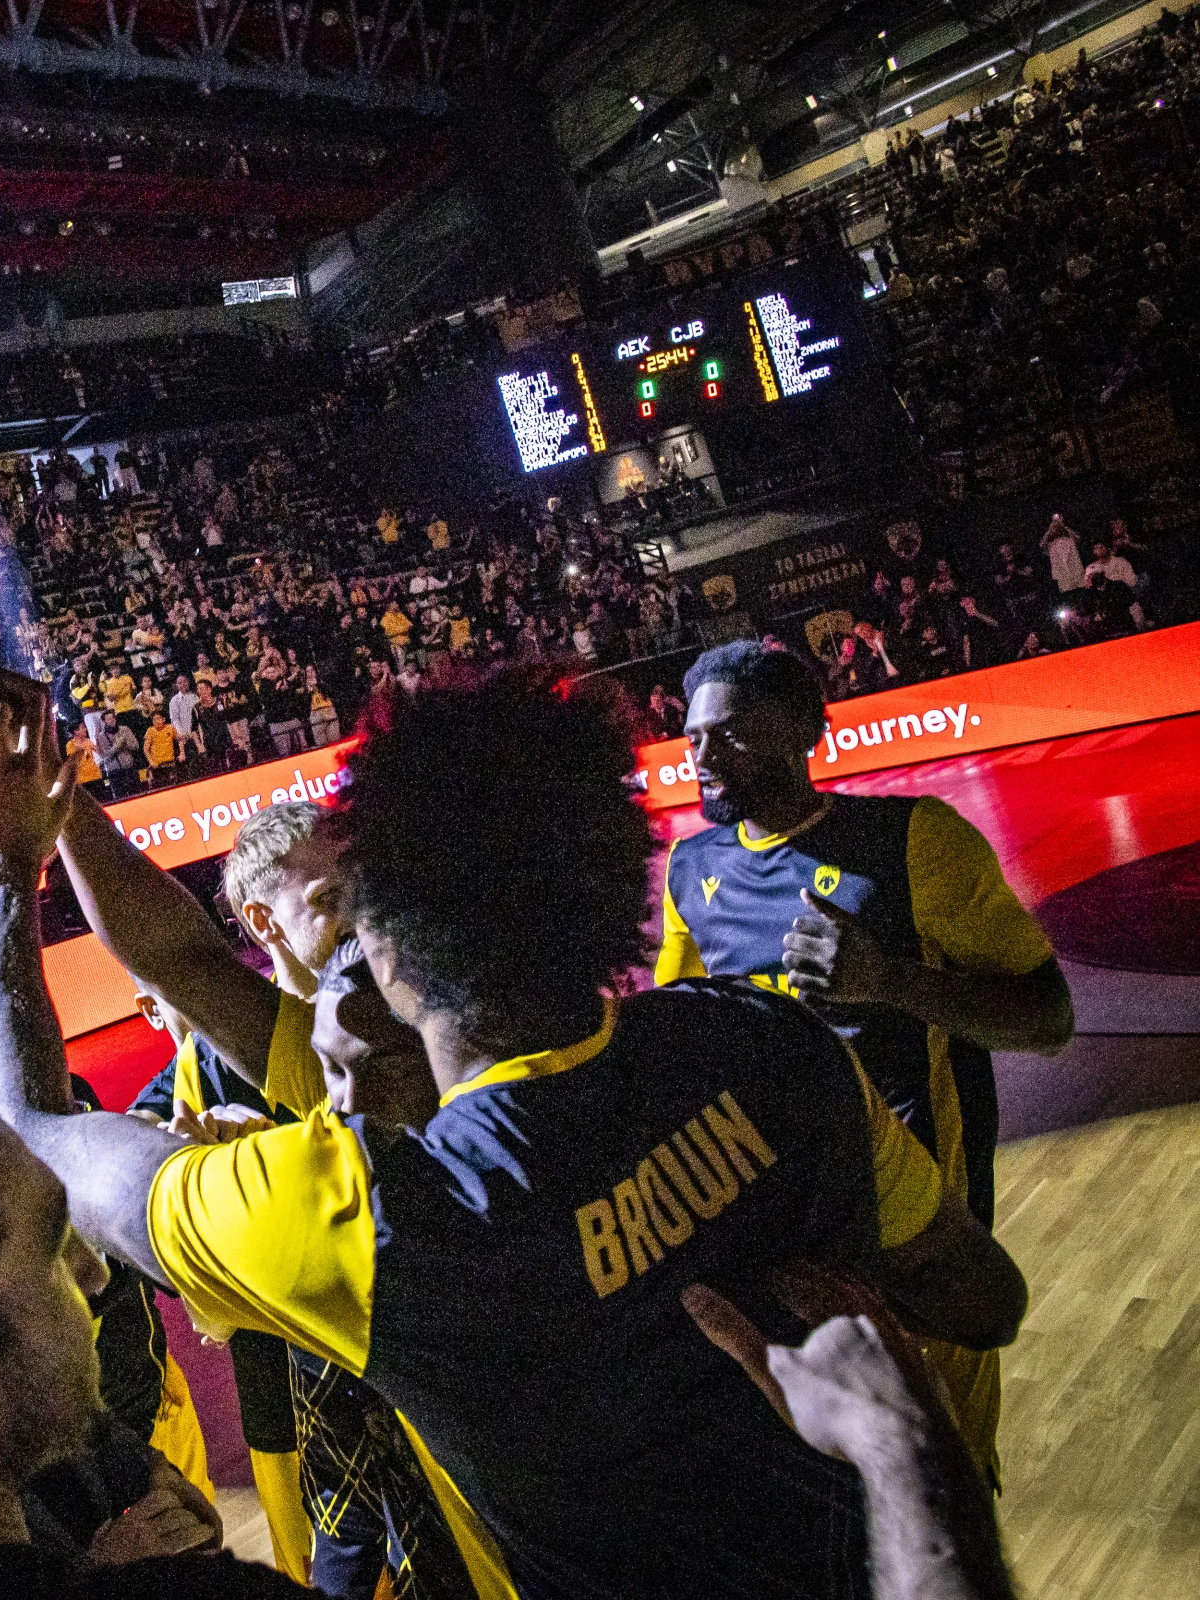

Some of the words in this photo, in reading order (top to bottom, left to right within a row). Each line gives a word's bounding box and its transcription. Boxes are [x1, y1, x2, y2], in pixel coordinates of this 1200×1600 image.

[670, 320, 704, 343] CJB
[617, 336, 651, 360] AEK
[645, 346, 689, 373] 25:44
[706, 362, 719, 380] 0
[641, 381, 654, 399] 0
[707, 383, 717, 397] 0
[641, 402, 652, 417] 0
[824, 703, 981, 764] journey.
[191, 794, 261, 842] your
[271, 769, 345, 805] educ
[575, 1089, 778, 1299] BROWN
